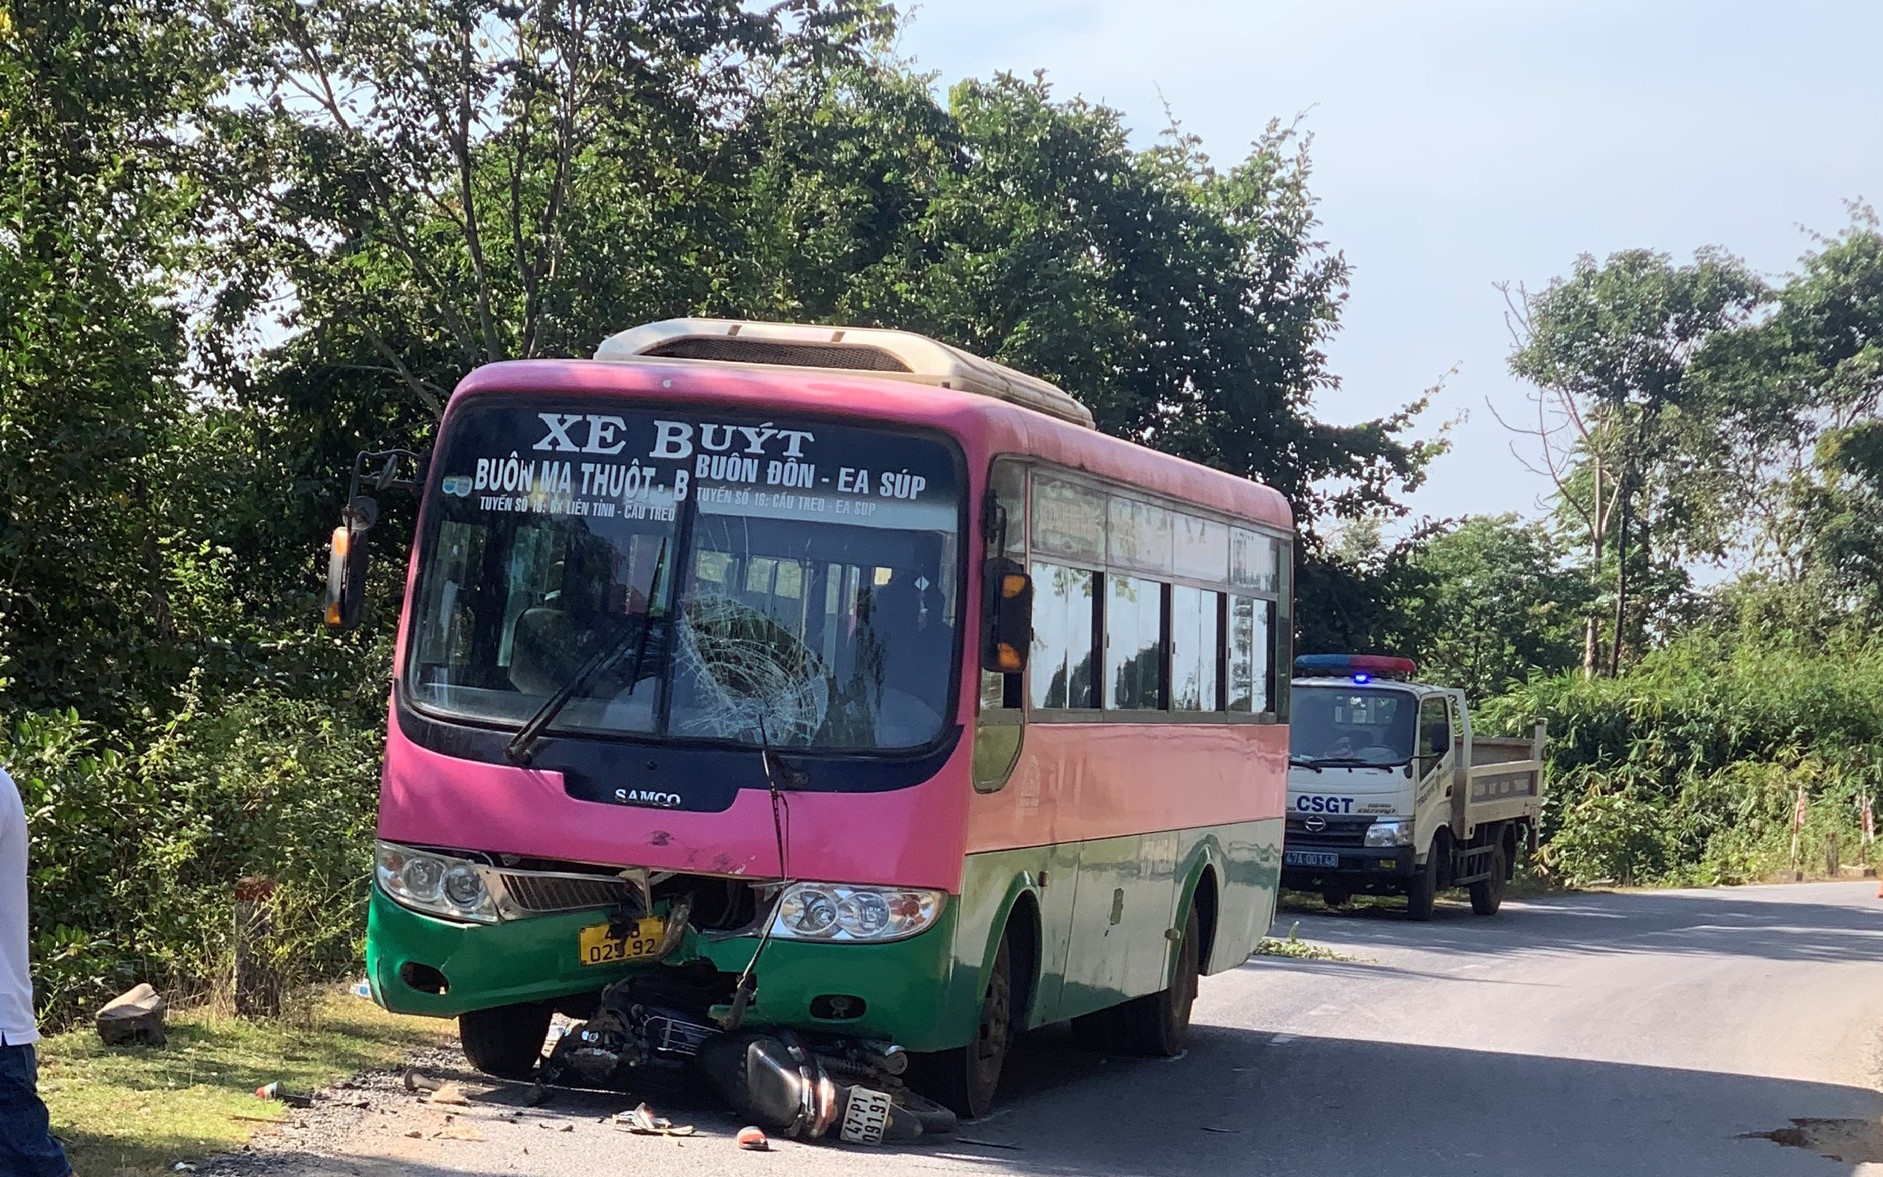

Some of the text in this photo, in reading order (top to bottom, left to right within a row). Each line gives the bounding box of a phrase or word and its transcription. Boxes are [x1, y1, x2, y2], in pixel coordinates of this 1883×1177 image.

[532, 412, 815, 459] XE BUÝT
[474, 451, 535, 493] BUÔN
[540, 461, 572, 494] MA
[695, 452, 759, 484] BUÔN
[767, 457, 816, 489] ĐÔN
[837, 467, 870, 494] EA
[879, 469, 927, 500] SÚP
[649, 507, 676, 522] TREO
[798, 495, 825, 512] TREO
[836, 499, 852, 515] EA
[615, 788, 681, 807] SAMCO
[1296, 795, 1354, 814] CSGT
[845, 1096, 869, 1135] 47-P1
[862, 1095, 887, 1143] 091.91
